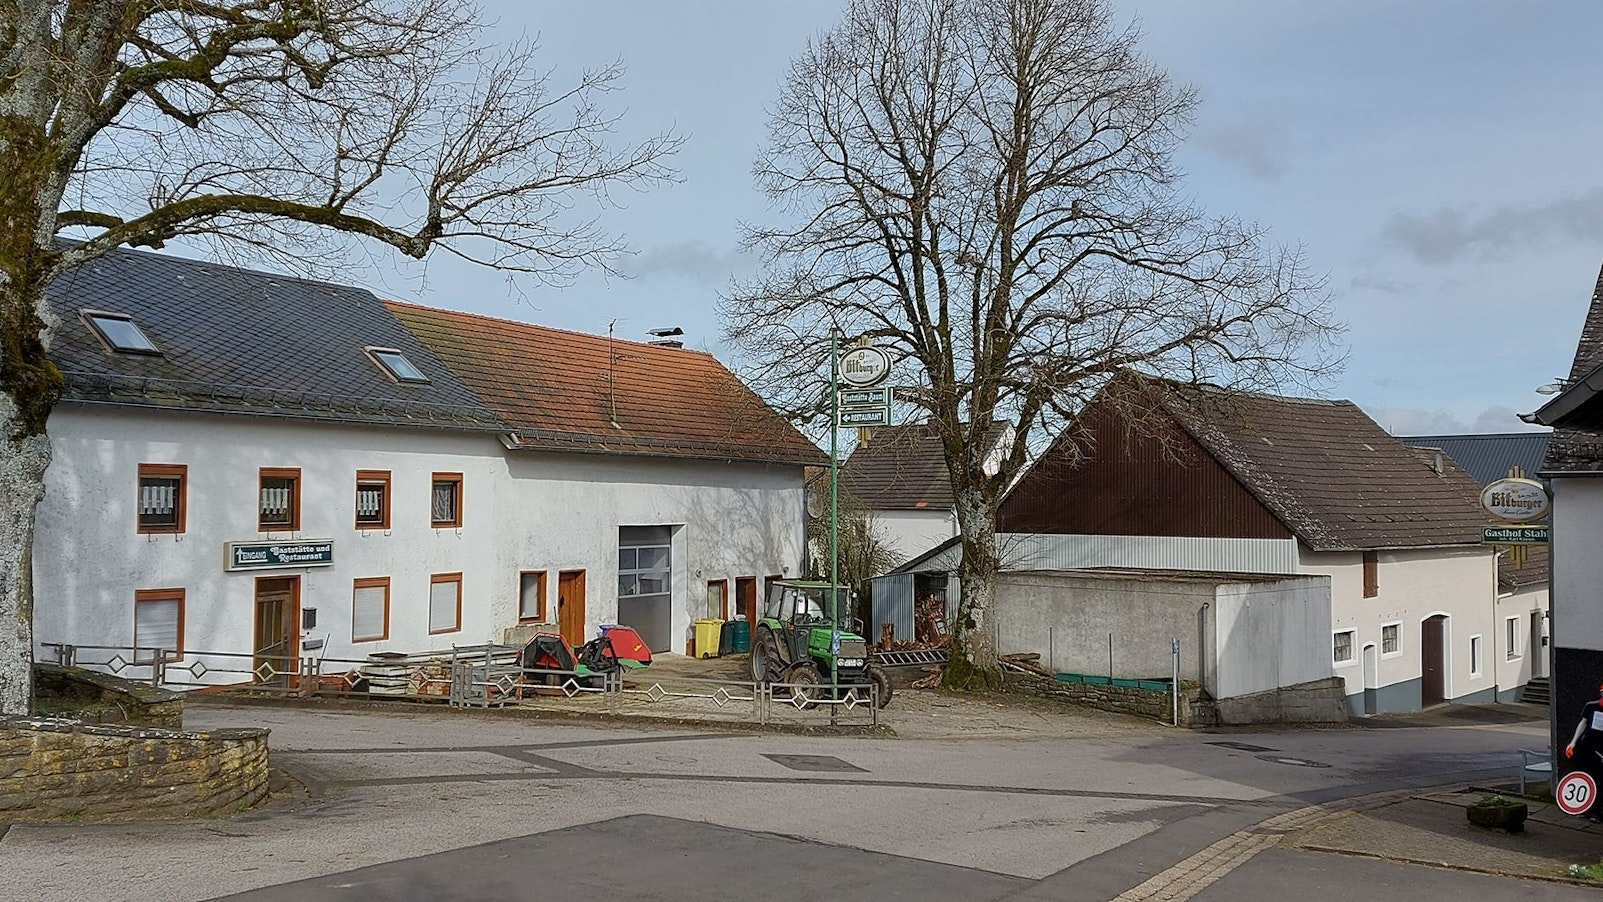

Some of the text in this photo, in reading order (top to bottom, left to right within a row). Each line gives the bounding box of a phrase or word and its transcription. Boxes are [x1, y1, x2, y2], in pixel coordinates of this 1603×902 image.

[850, 413, 882, 422] RESTAURANT
[1491, 491, 1542, 510] Bitburger
[1485, 529, 1521, 537] Gasthof
[270, 545, 314, 556] Gaststätte
[242, 551, 267, 560] EINGANG
[278, 553, 322, 562] Restaurant
[1564, 783, 1588, 802] 30
